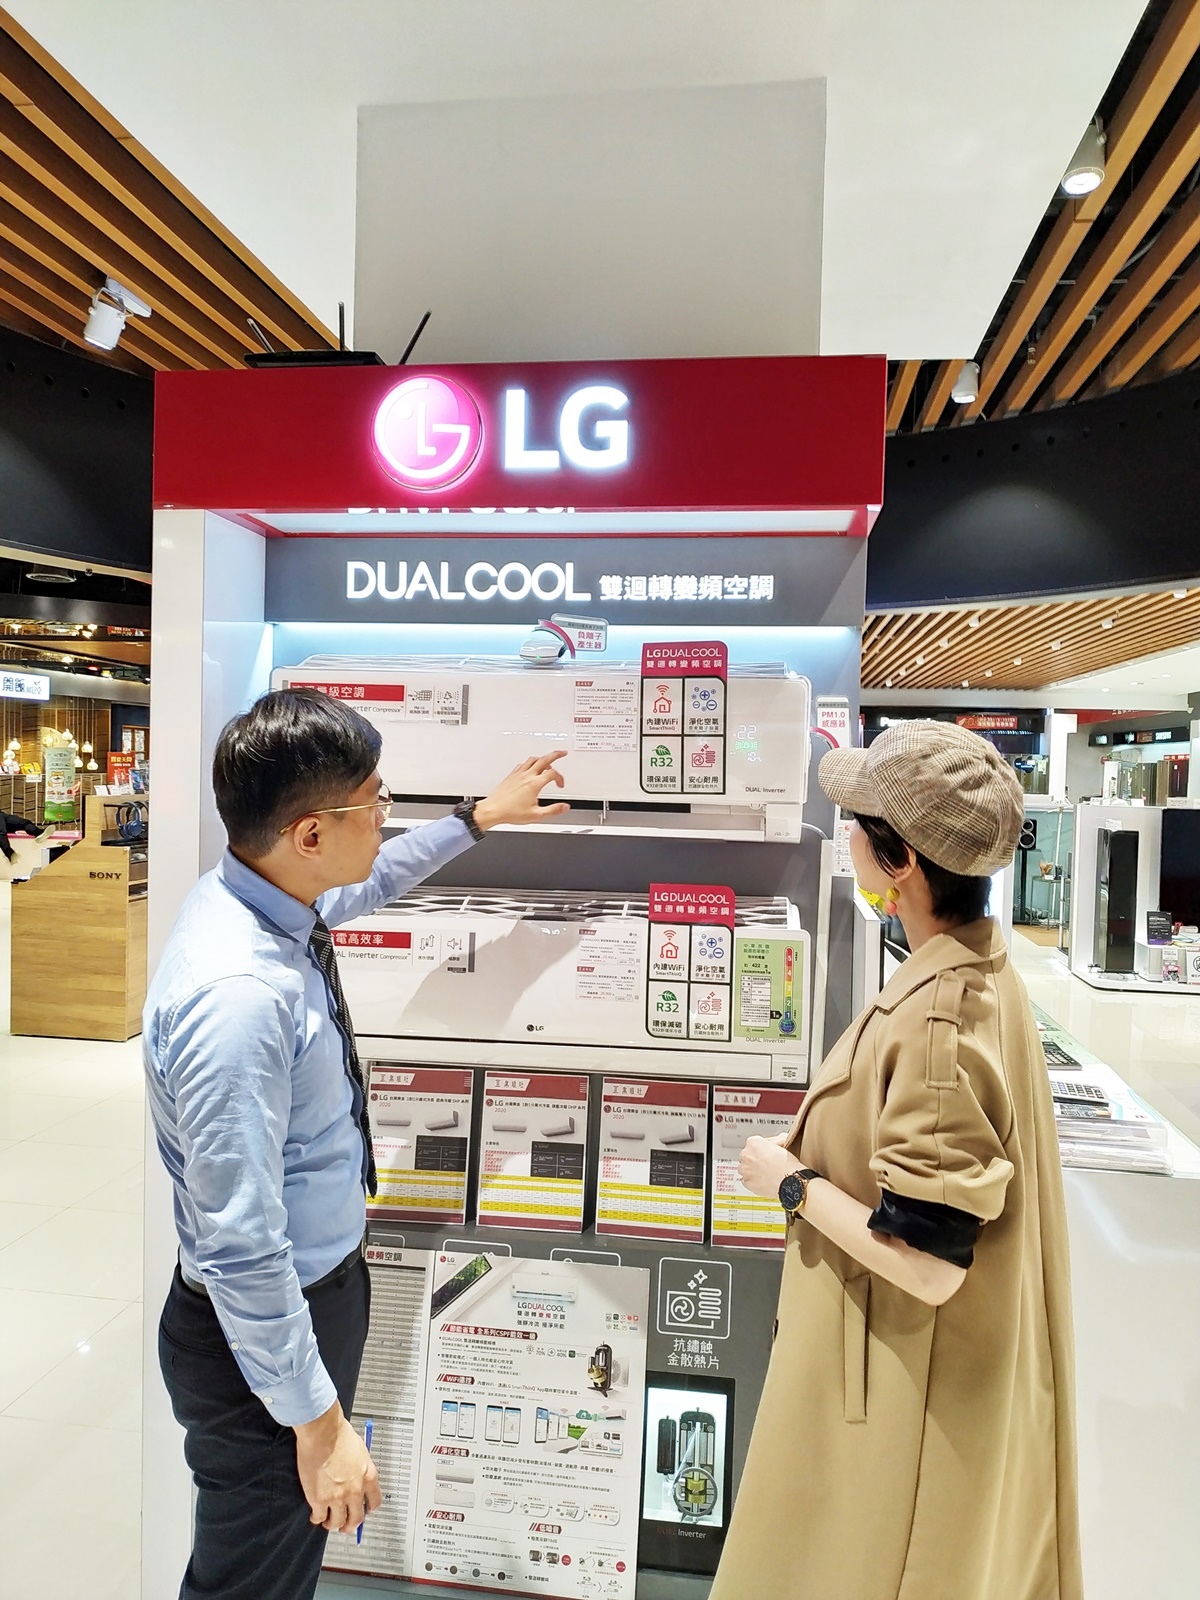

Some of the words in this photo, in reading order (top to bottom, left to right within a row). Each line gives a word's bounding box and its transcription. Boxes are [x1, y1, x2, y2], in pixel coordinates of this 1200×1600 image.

[504, 387, 629, 469] LG
[346, 561, 591, 600] DUALCOOL
[599, 575, 775, 601] 雙迴轉變頻空調
[578, 630, 602, 640] 負離子
[578, 640, 602, 649] 產生器
[646, 718, 678, 726] 內建WiFi
[689, 718, 719, 726] 淨化空氣
[650, 757, 673, 767] R32
[689, 776, 718, 784] 安心耐用
[331, 932, 384, 950] 電高效率
[348, 951, 379, 959] Inverter
[653, 963, 685, 971] 內建WiFi
[696, 965, 725, 974] 淨化空氣
[656, 1002, 679, 1013] R32
[695, 1023, 724, 1031] 安心耐用
[367, 1250, 402, 1262] 變頻空調
[673, 1338, 713, 1355] 抗鏽蝕
[667, 1353, 720, 1370] 金散熱片
[436, 1512, 462, 1521] 安心耐用
[678, 1529, 706, 1538] Inverter
